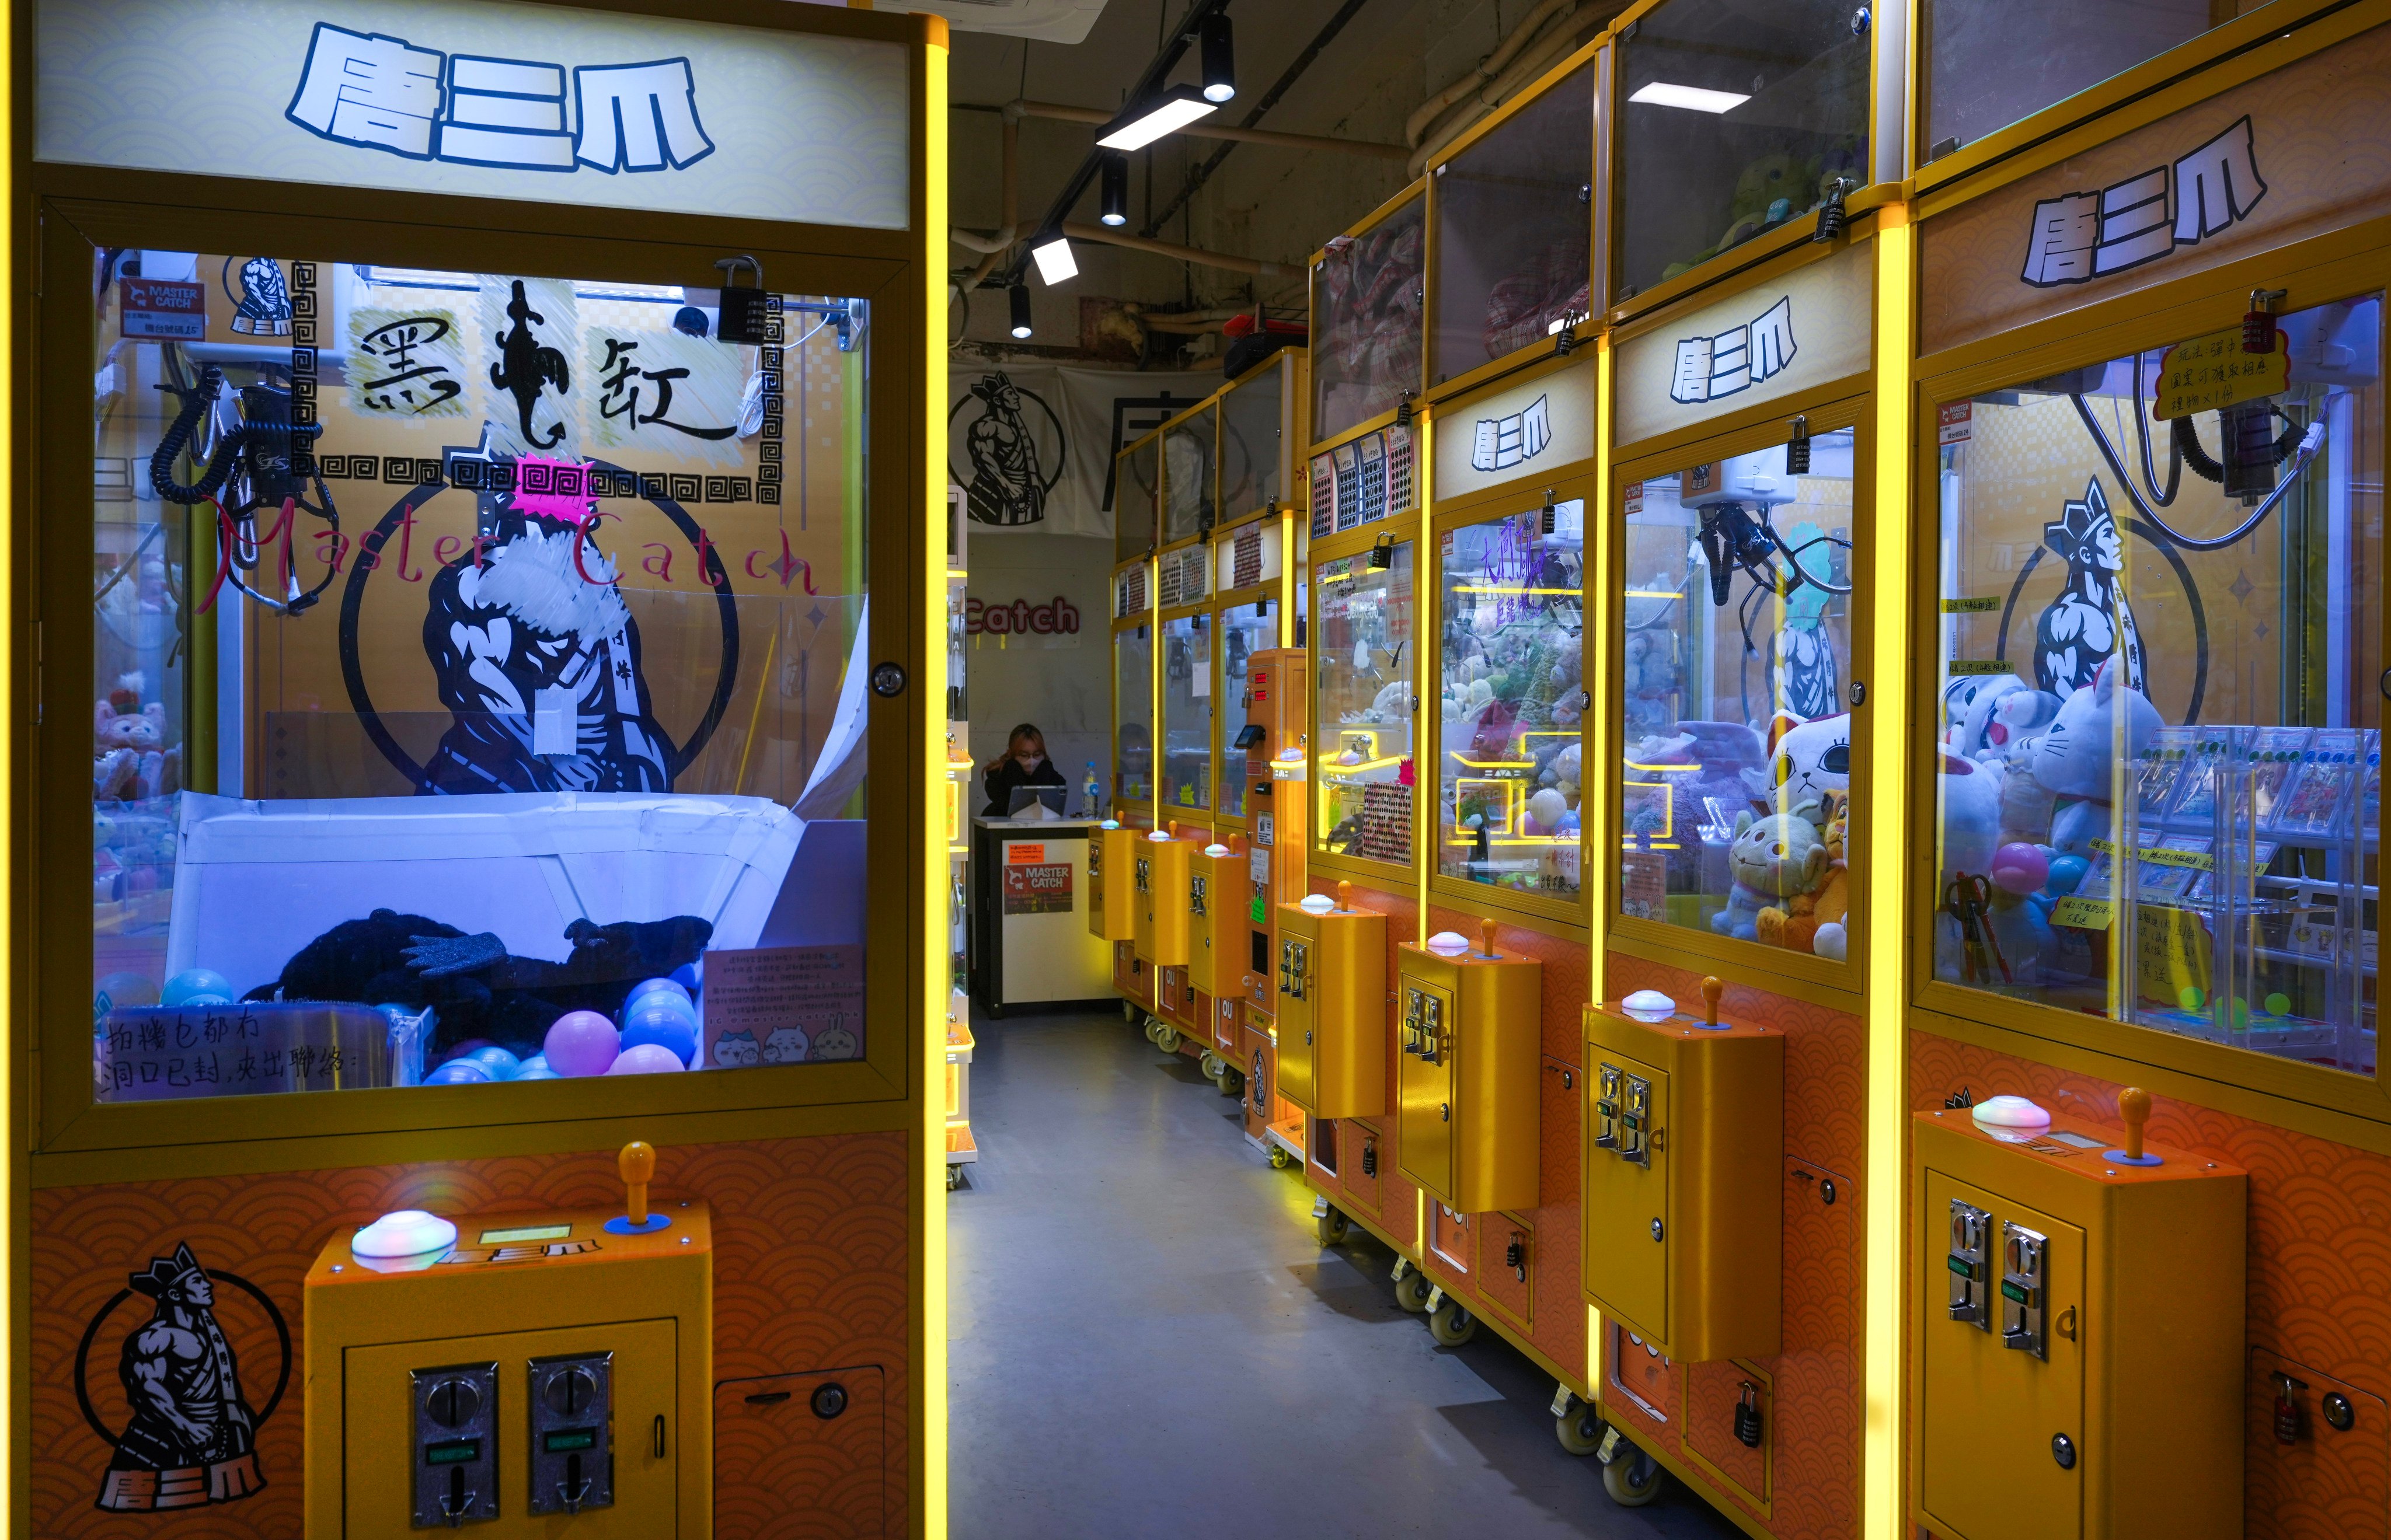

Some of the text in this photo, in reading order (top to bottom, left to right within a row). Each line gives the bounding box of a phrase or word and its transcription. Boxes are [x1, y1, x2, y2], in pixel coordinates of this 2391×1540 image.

[284, 21, 716, 175] 唐三爪
[2020, 114, 2268, 288] 唐三爪
[149, 285, 197, 299] MASTER
[155, 296, 191, 309] CATCH
[230, 316, 292, 337] 唐三爪
[361, 317, 461, 413] 黑
[1670, 295, 1797, 404] 唐三爪
[2178, 338, 2250, 363] 玩法:彈中
[2171, 356, 2268, 389] 圖案可獲取相應
[1950, 403, 1969, 414] MASTER
[1952, 411, 1966, 420] CATCH
[1471, 393, 1552, 472] 唐三爪
[194, 494, 820, 615] Master Catch
[967, 595, 1080, 635] Catch
[1026, 867, 1069, 878] MASTER
[1031, 877, 1063, 888] CATCH
[94, 1453, 268, 1514] 唐三爪
